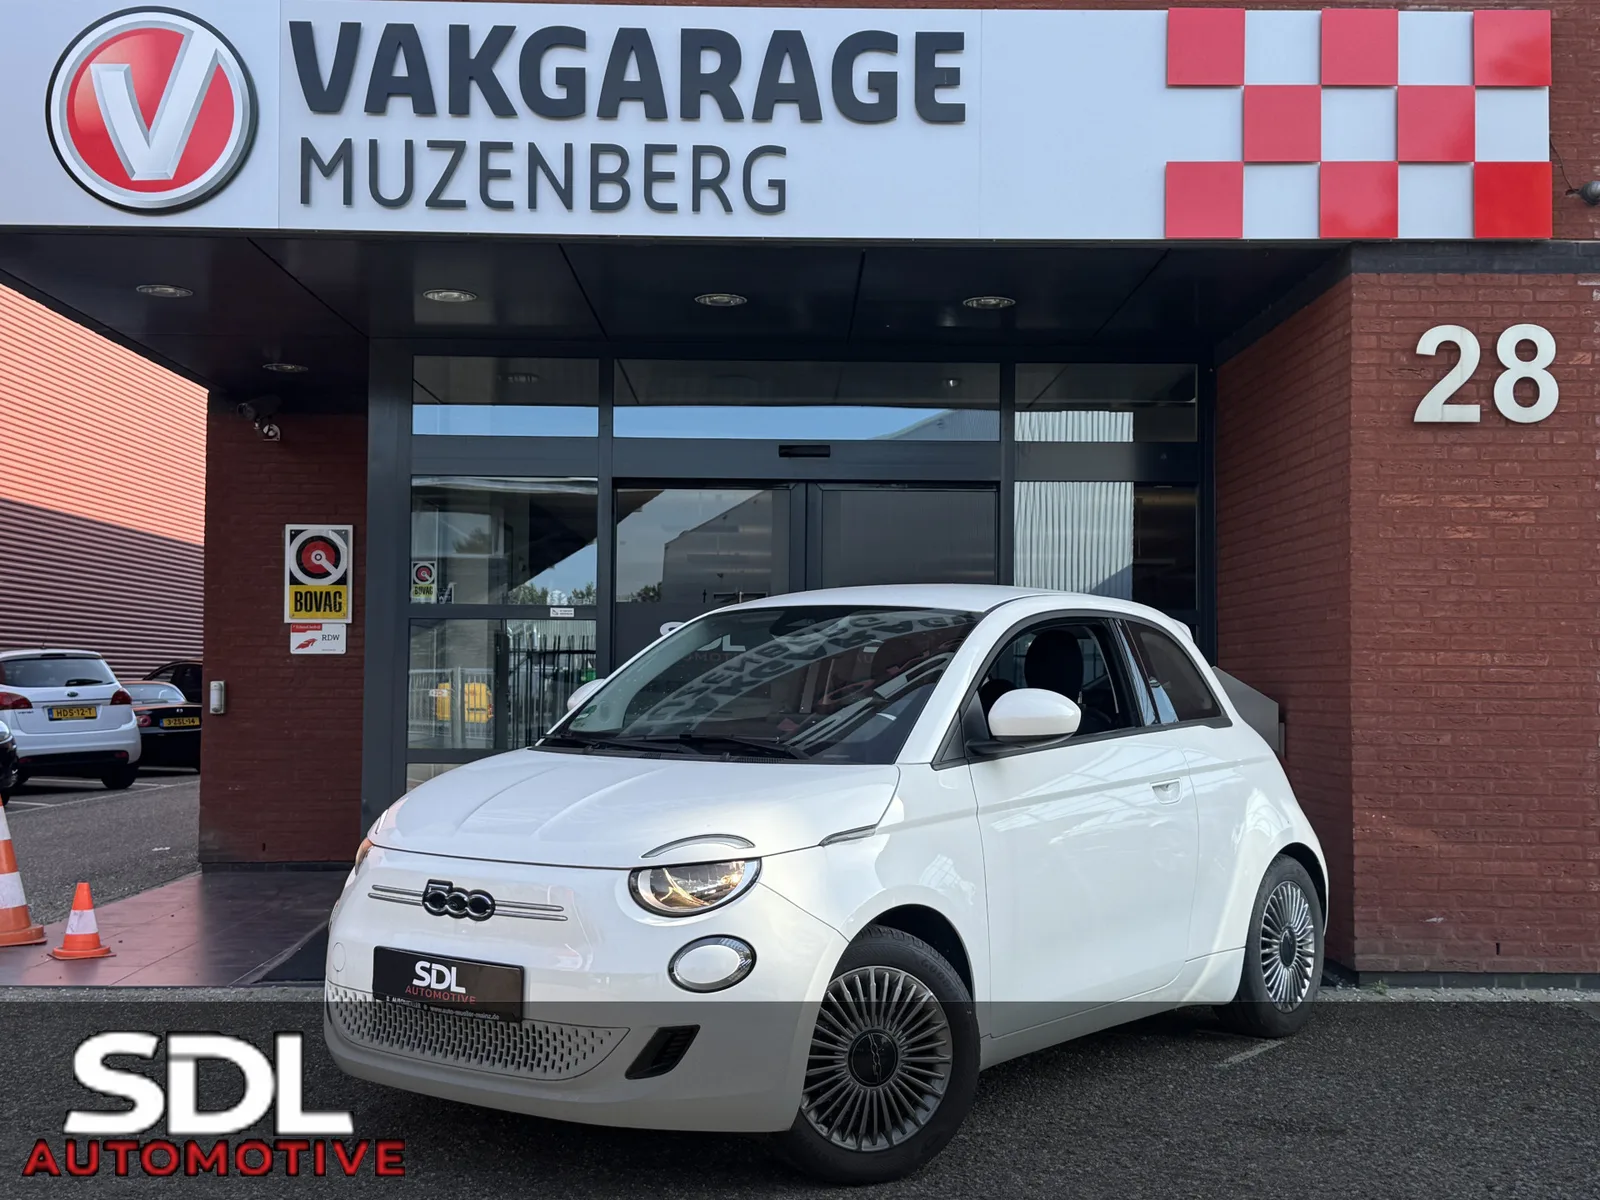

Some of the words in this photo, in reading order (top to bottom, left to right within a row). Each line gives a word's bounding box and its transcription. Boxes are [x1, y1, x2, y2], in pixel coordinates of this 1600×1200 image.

[288, 20, 966, 124] VAKGARAGE
[300, 137, 787, 214] MUZENBERG
[1413, 323, 1560, 424] 28
[294, 590, 342, 613] BOVAG
[422, 879, 496, 921] 500
[405, 985, 476, 1005] AUTOMOTIVE
[412, 960, 466, 994] SDL
